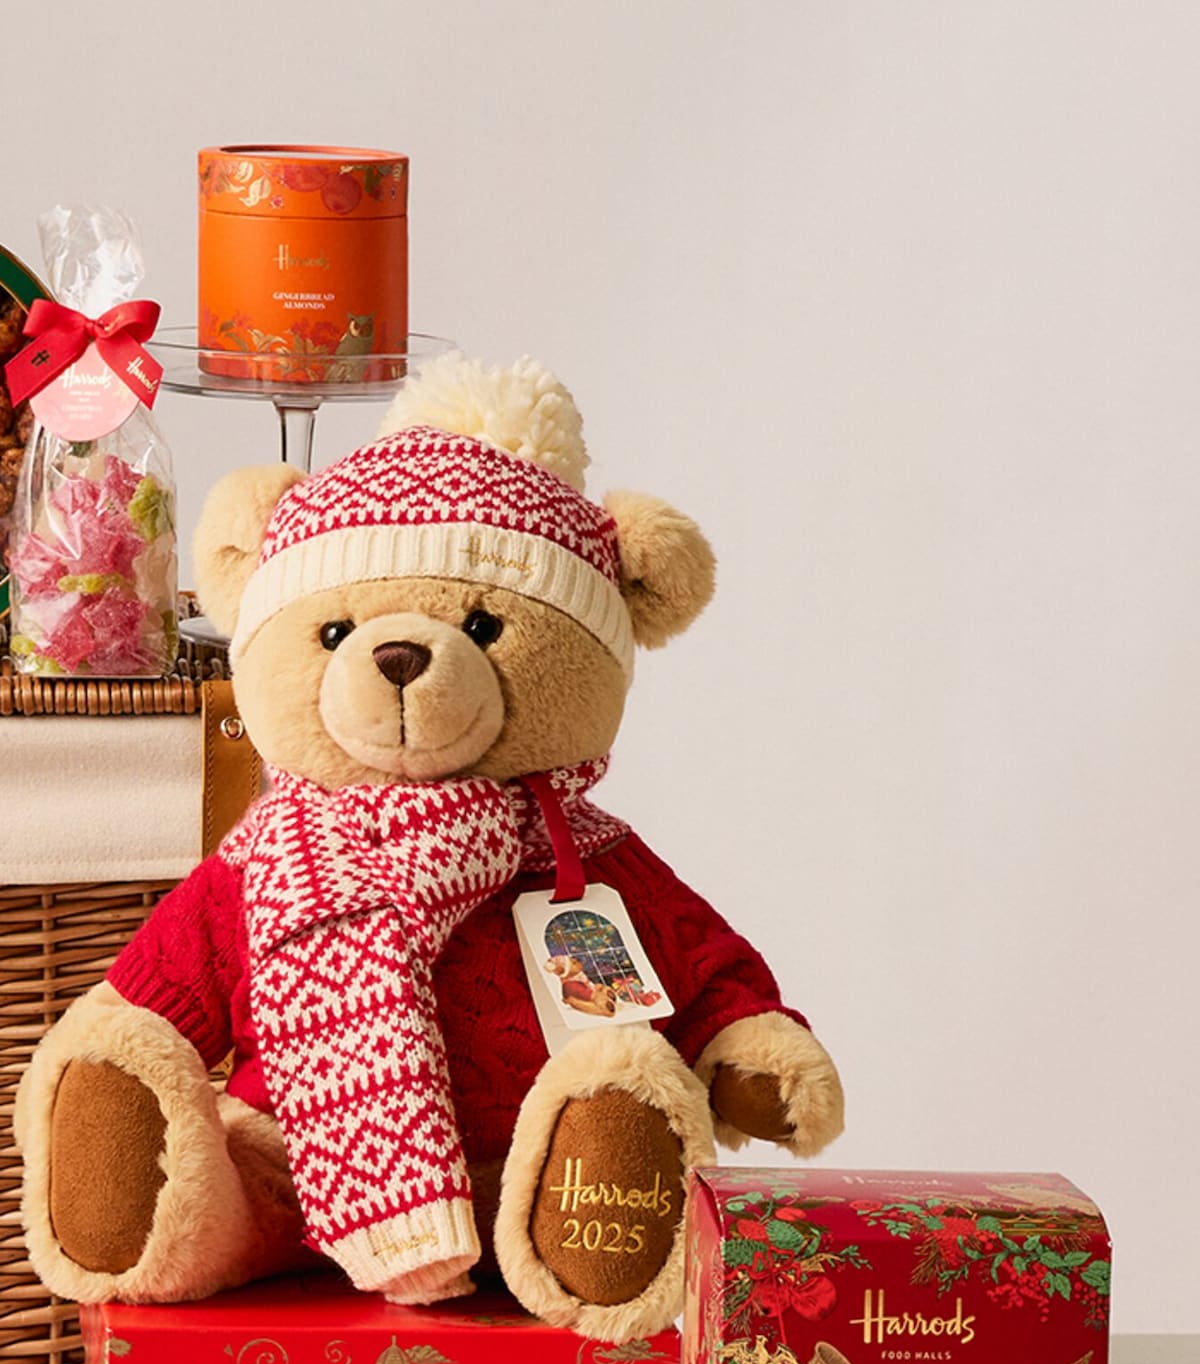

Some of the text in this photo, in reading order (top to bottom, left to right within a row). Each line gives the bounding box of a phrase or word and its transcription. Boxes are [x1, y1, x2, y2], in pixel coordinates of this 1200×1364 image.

[272, 244, 330, 271] Harrods
[272, 292, 335, 301] GINGERBREAD
[283, 302, 326, 310] ALMONDS
[59, 363, 113, 390] Harrods
[459, 536, 536, 577] Harrods
[549, 1157, 672, 1217] Harrods
[561, 1218, 645, 1254] 2025
[849, 1288, 976, 1344] Harrods
[881, 1351, 952, 1360] FOOD HALLS
